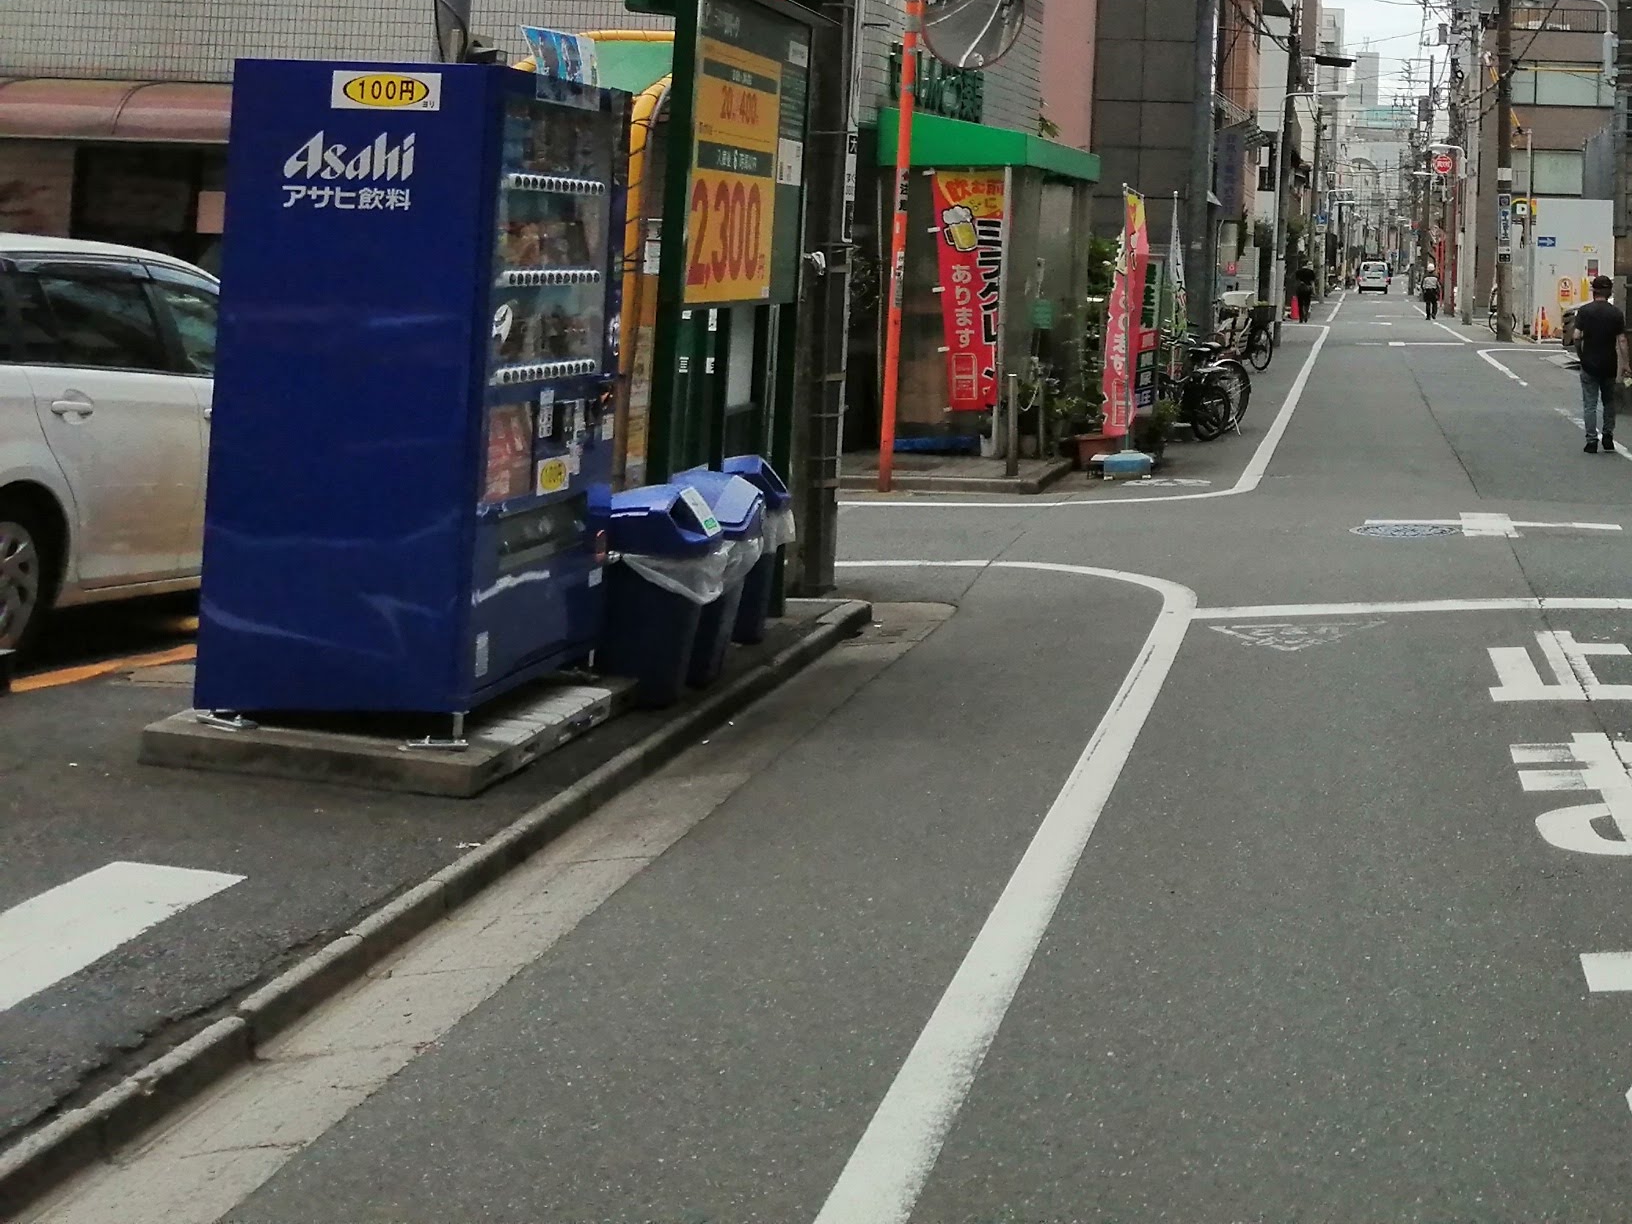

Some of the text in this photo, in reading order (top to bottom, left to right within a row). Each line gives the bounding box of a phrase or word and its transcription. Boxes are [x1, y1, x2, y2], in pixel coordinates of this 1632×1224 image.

[358, 80, 415, 101] 100円
[283, 130, 416, 182] Asahi
[282, 185, 411, 211] アサヒ飲料
[951, 264, 975, 348] あります
